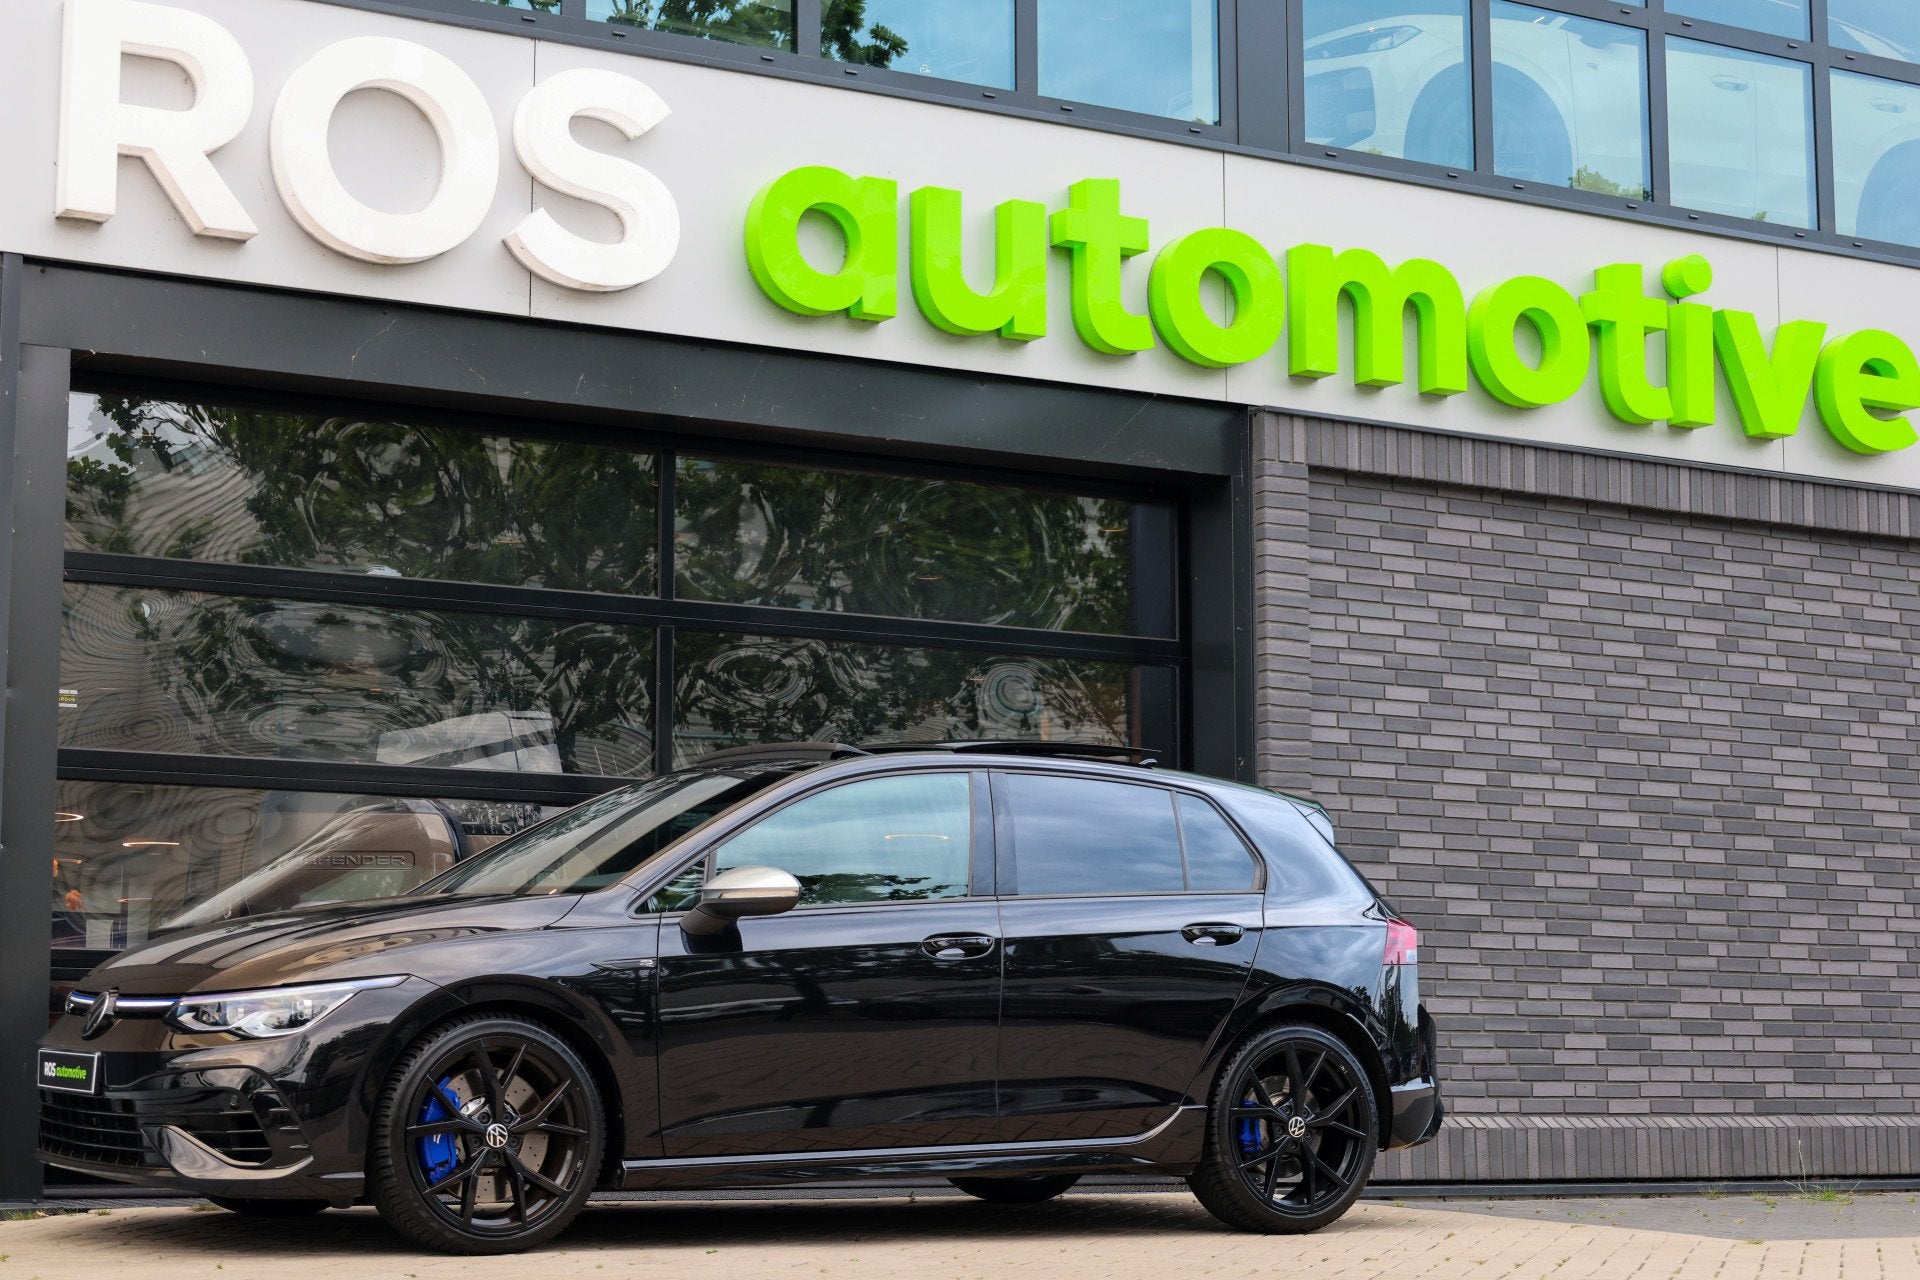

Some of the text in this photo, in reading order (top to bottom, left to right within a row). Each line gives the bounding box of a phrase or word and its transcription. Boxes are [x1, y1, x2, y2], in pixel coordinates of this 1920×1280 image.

[55, 0, 1920, 456] ROS automotive
[44, 1061, 86, 1079] ROS automotive
